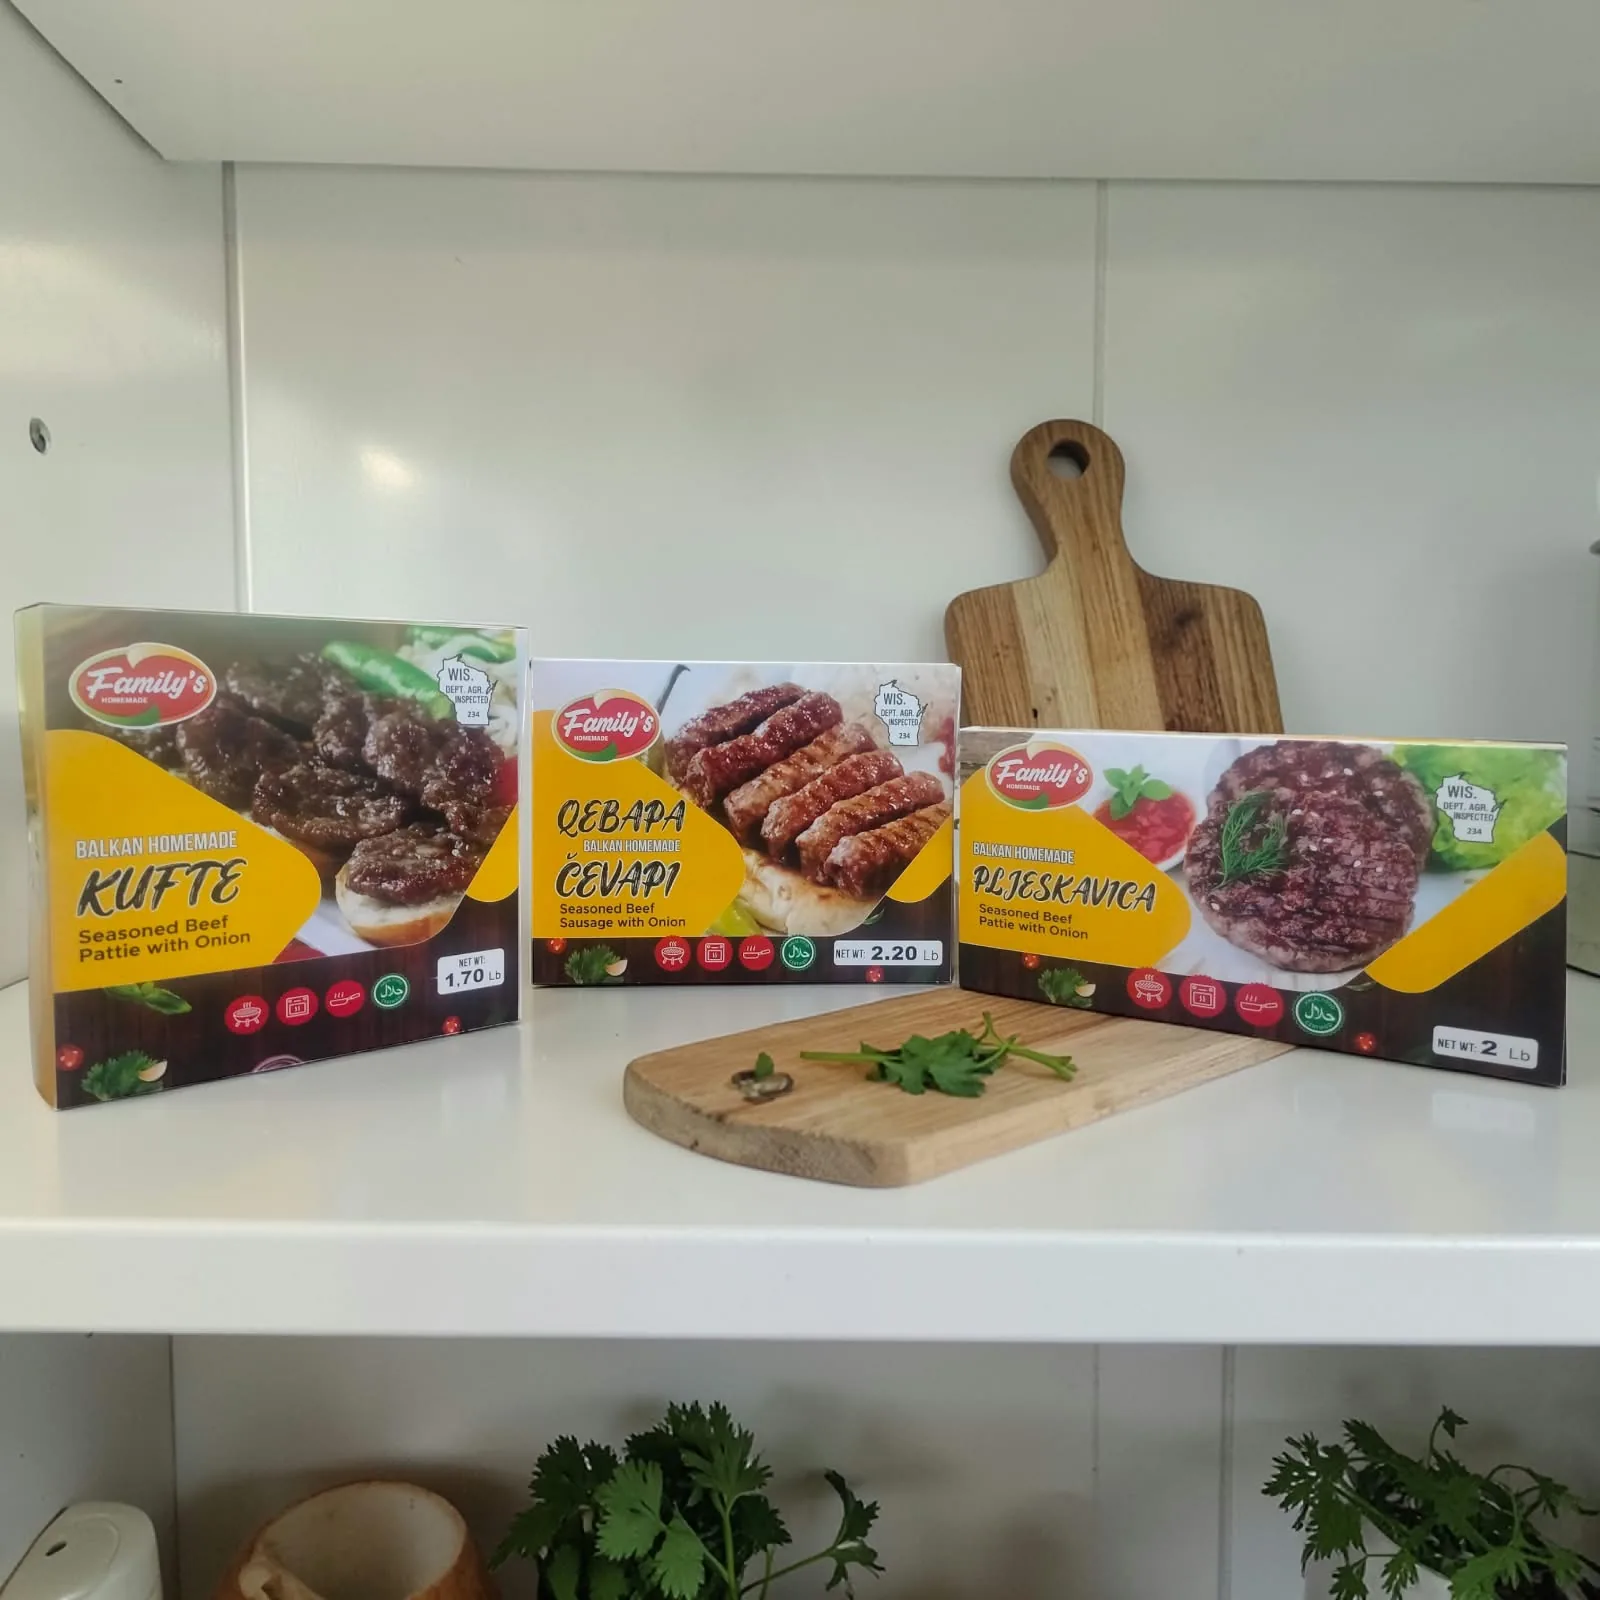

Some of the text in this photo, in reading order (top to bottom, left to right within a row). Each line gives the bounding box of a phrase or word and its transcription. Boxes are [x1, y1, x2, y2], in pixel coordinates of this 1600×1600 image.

[86, 667, 207, 700] Family's
[448, 668, 474, 681] WIS.
[446, 686, 484, 694] DEPT. AGR.
[455, 695, 488, 704] INSPECTED
[884, 693, 906, 705] WIS.
[563, 708, 654, 738] Family's
[996, 759, 1088, 788] Family's
[1447, 785, 1478, 799] WIS.
[1443, 802, 1488, 811] DEPT. AGR.
[1453, 812, 1494, 822] INSPECTED
[557, 799, 686, 838] QEBAPA
[76, 831, 238, 859] BALKAN HOMEMADE
[583, 840, 681, 852] BALKAN HOMEMADE
[973, 841, 1075, 865] BALKAN HOMEMADE
[555, 852, 681, 899] ČEVAPI
[76, 857, 248, 918] KUFTE
[973, 864, 1158, 914] PLJESKAVICA
[560, 902, 655, 914] Seasoned Beef
[979, 903, 1073, 925] Seasoned Beef
[79, 915, 228, 944] Seasoned Beef
[560, 917, 686, 930] Sausage with Onion
[979, 916, 1088, 939] Pattie with Onion
[79, 932, 250, 963] Pattie with Onion
[836, 946, 939, 961] NET WT: 2.20 Lb
[458, 956, 486, 967] NET WT:
[489, 970, 501, 980] Lb
[1438, 1038, 1530, 1061] NET WT: 2 Lb
